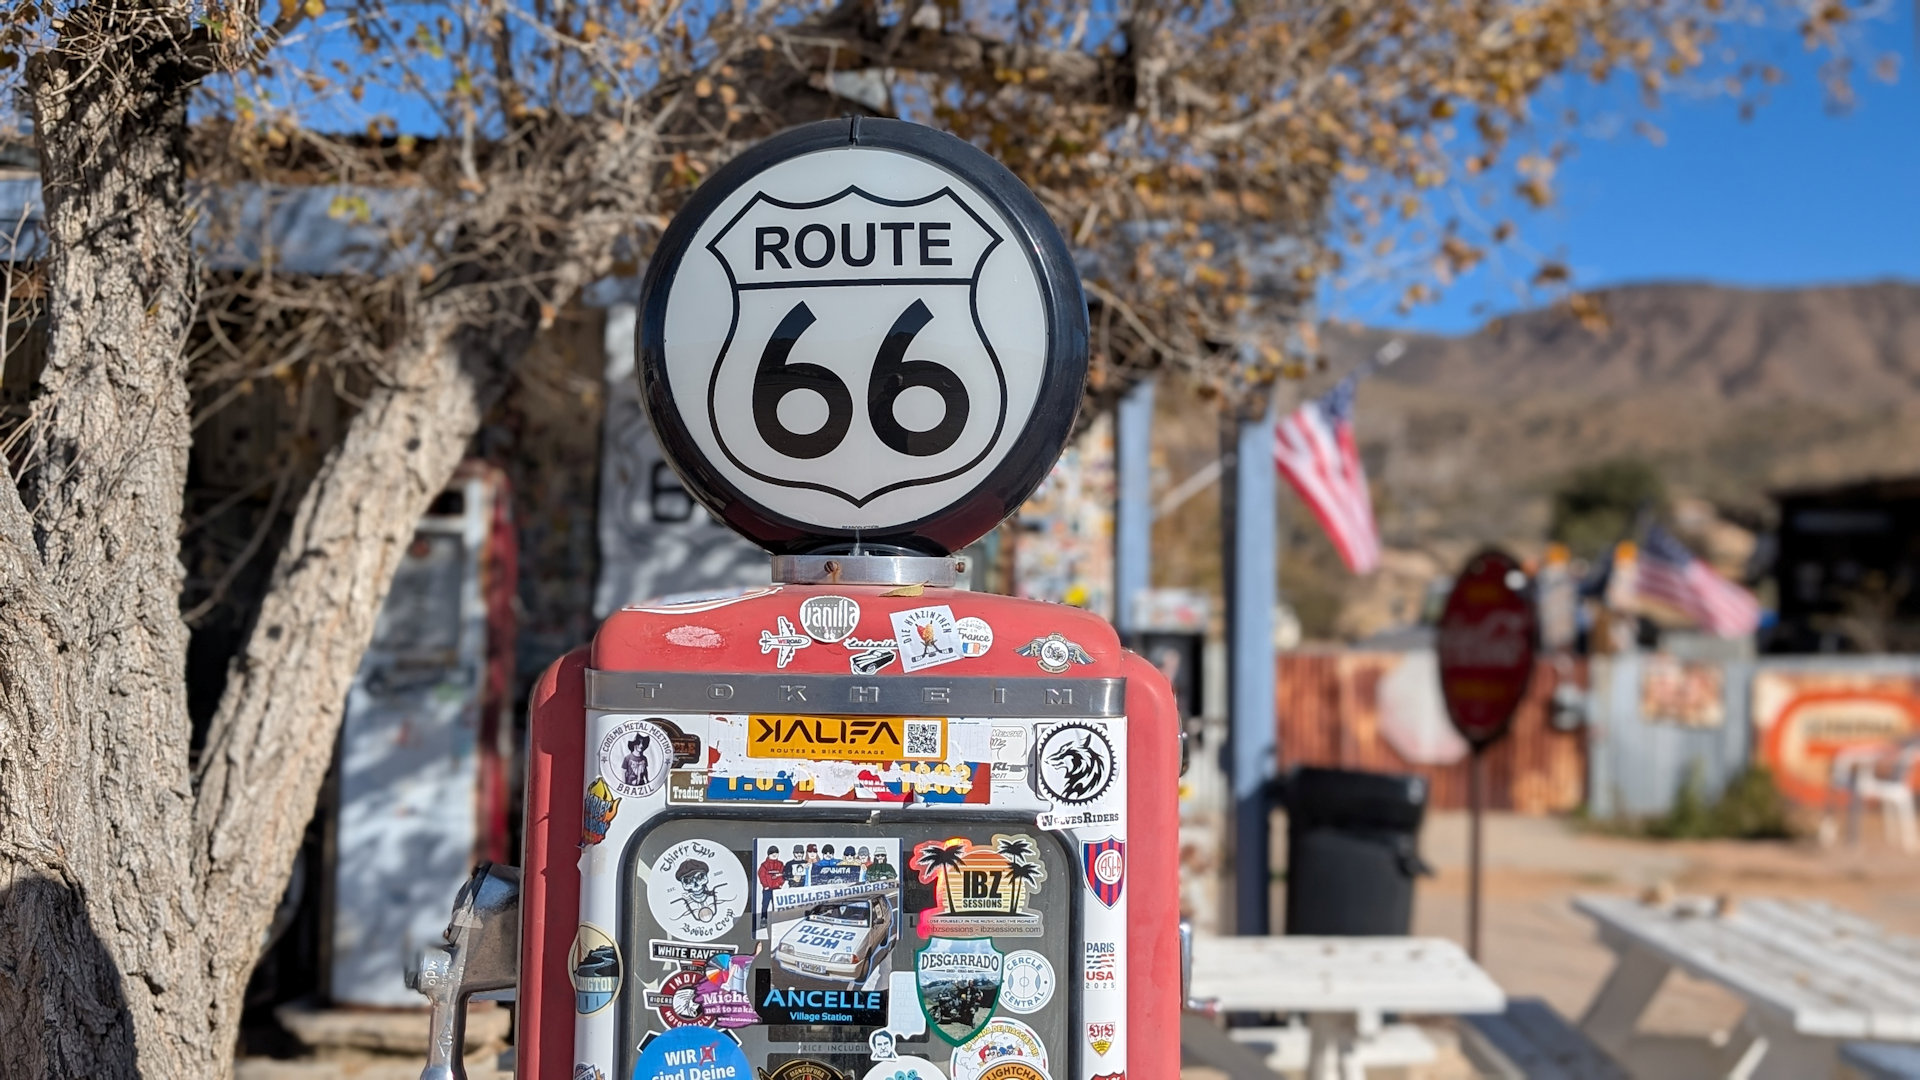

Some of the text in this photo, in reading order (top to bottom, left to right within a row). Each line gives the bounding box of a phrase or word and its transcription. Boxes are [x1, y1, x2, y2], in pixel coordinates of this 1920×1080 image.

[754, 223, 953, 271] ROUTE
[752, 298, 970, 459] 66
[904, 610, 953, 634] HYAZINTHEN
[902, 629, 912, 644] DIE
[957, 628, 991, 642] France
[636, 682, 1074, 706] TOKHEIM
[624, 722, 649, 732] METAL
[755, 718, 901, 745] KALIFA
[617, 785, 654, 796] BRAZIL
[673, 786, 704, 802] Trading
[963, 870, 1003, 899] IBZ
[776, 890, 831, 907] VIEILLES
[962, 899, 1003, 909] SESSIONS
[658, 946, 688, 959] WHITE
[1086, 942, 1115, 953] PARIS
[921, 953, 1000, 972] DESGARRADO
[1006, 957, 1044, 971] CERCLE
[1086, 970, 1115, 981] USA
[762, 989, 881, 1009] ANCELLE
[1004, 991, 1045, 1008] CENTRAL
[790, 1011, 853, 1023] Village Station
[664, 1049, 698, 1066] WIR
[689, 1064, 737, 1080] Deine
